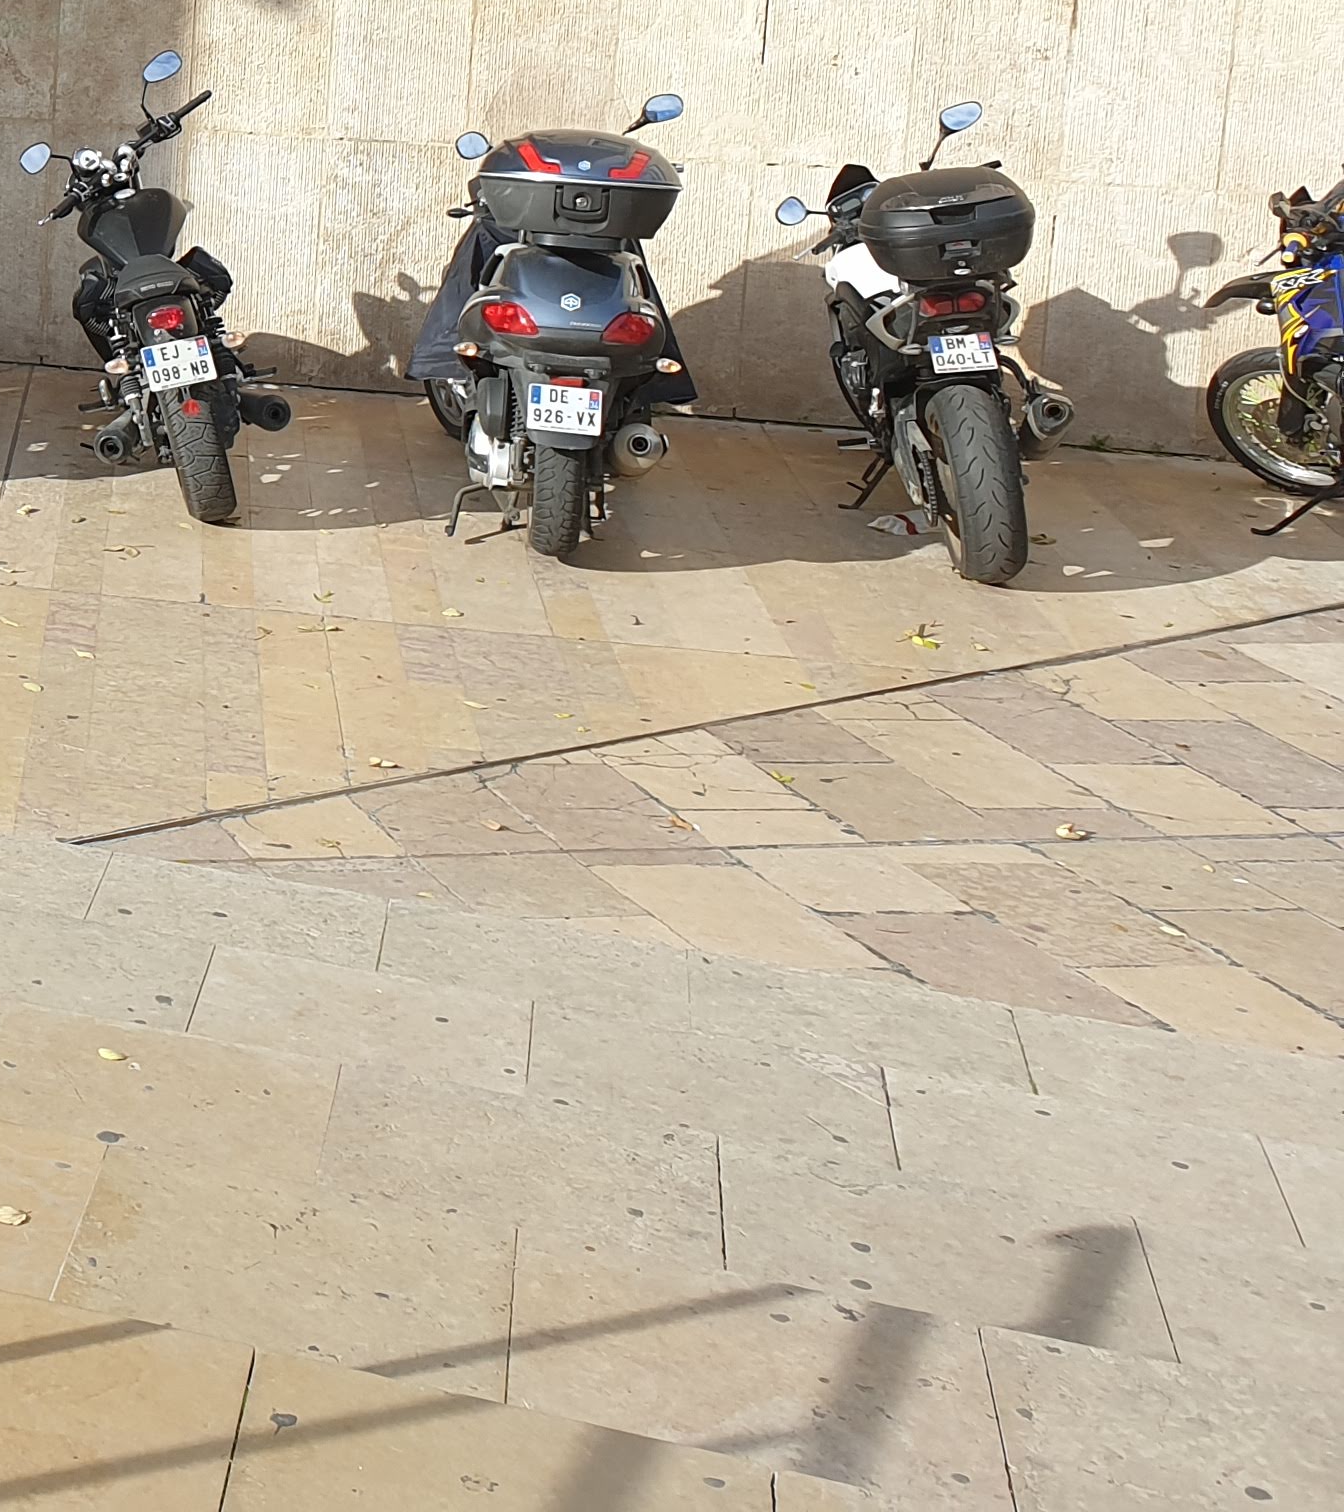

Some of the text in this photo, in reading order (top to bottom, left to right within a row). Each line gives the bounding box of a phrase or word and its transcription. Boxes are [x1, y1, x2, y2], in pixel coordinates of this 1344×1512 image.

[935, 351, 991, 367] 040-LT
[152, 359, 209, 384] 098-NB
[533, 408, 596, 427] 926-VX
